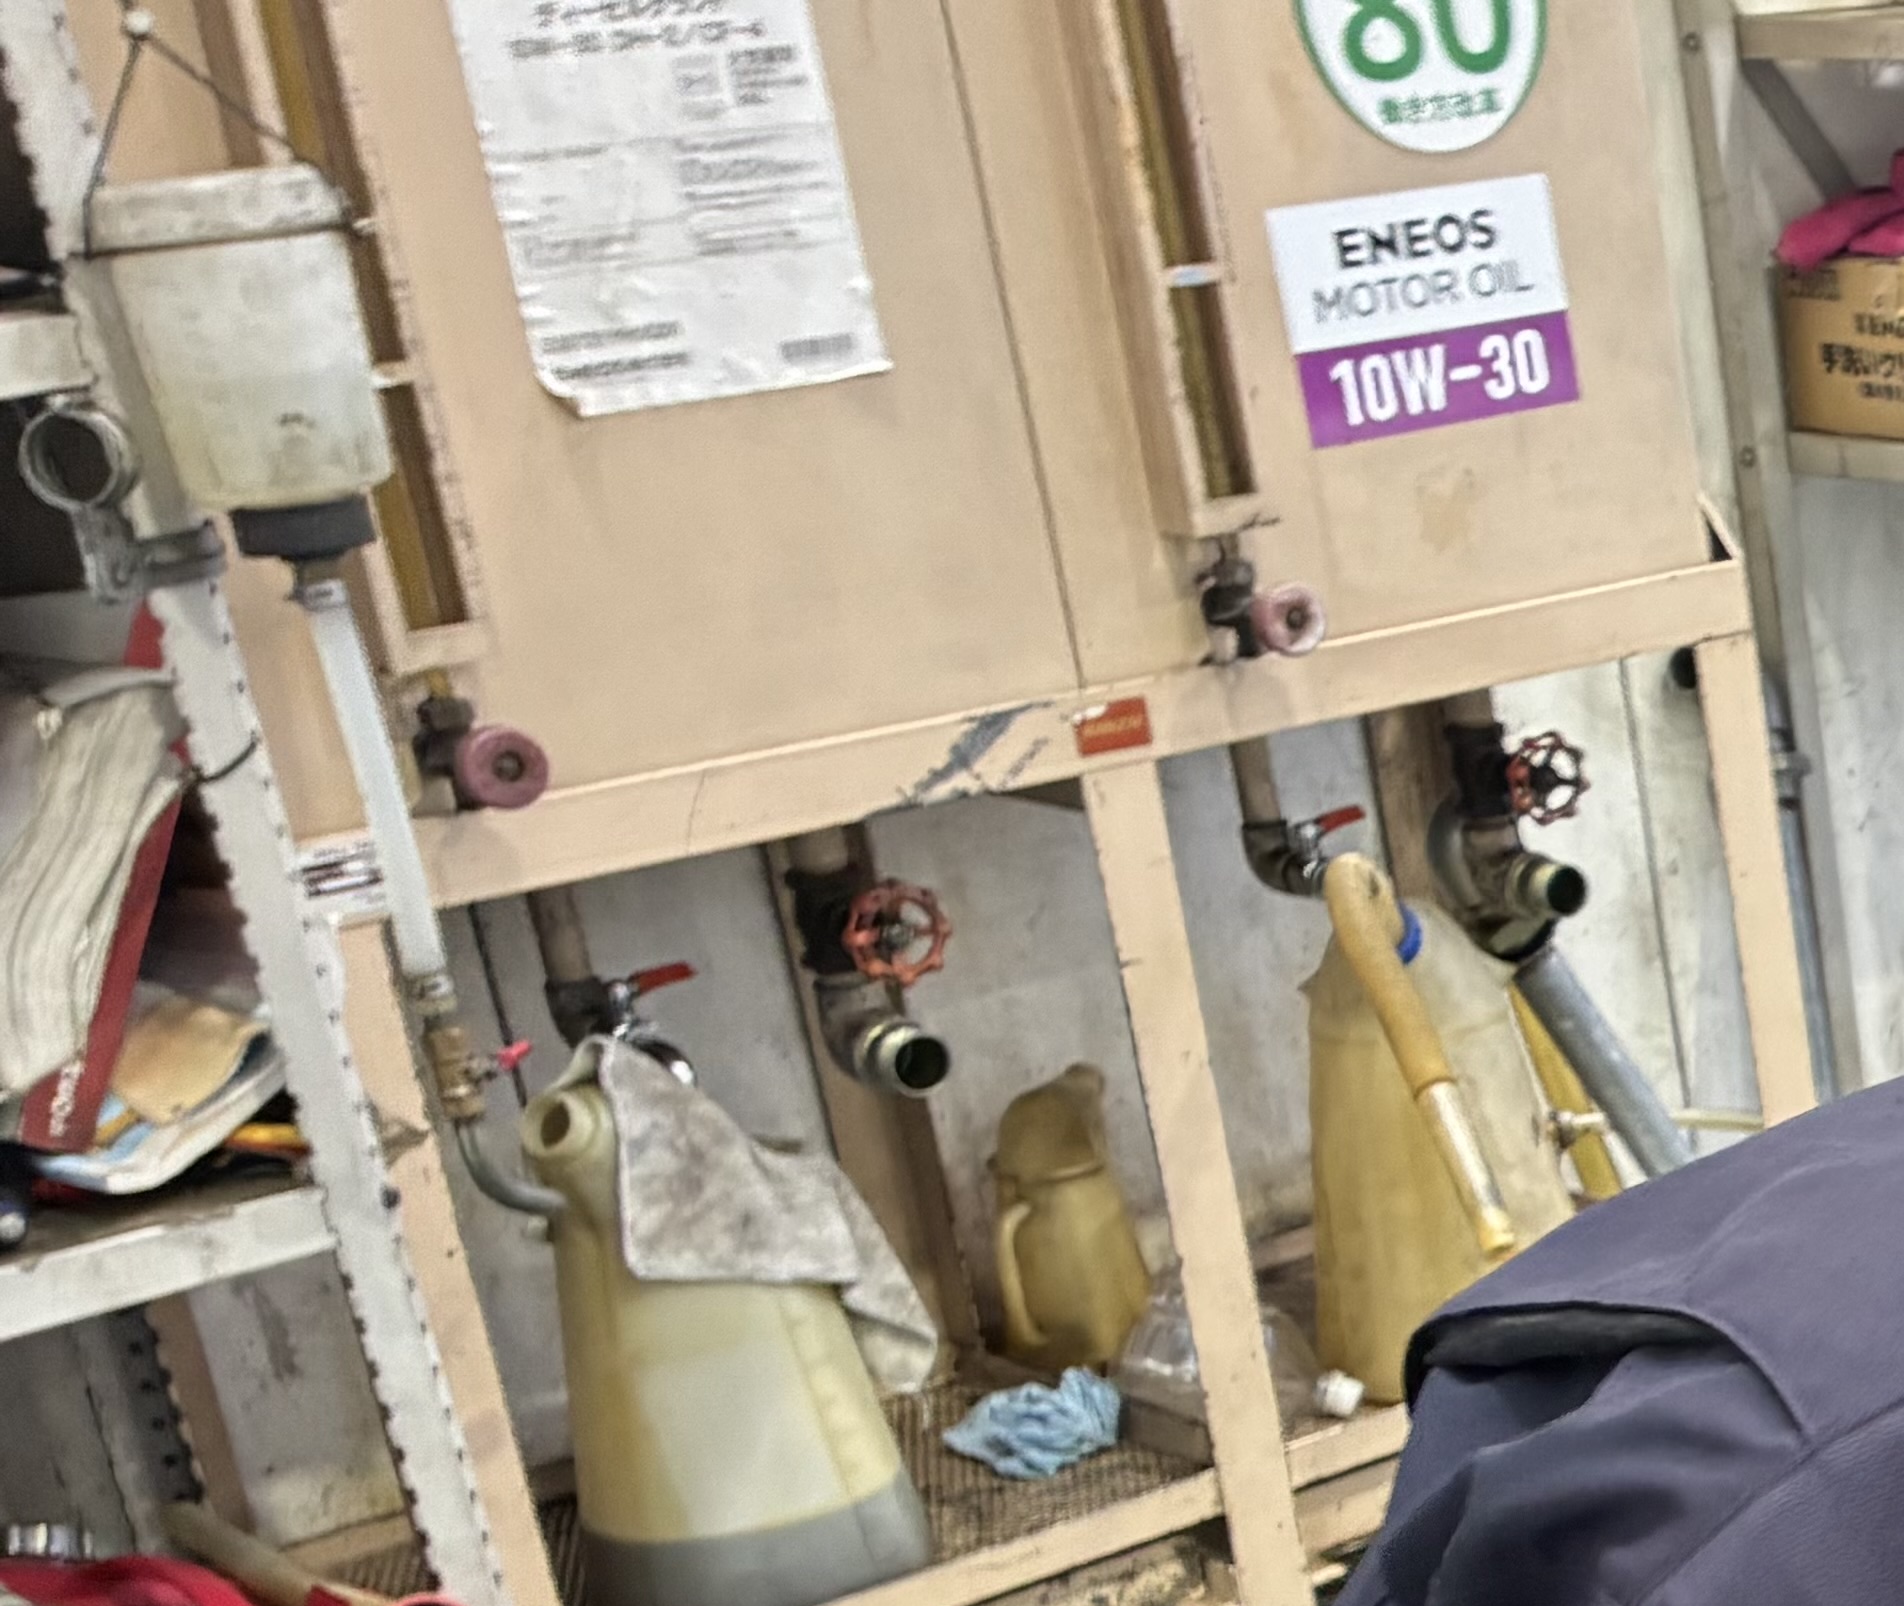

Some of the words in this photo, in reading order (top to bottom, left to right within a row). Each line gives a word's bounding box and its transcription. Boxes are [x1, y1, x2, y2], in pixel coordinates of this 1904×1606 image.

[1333, 209, 1498, 268] ENEOS
[1313, 268, 1462, 323] MOTOR
[1468, 260, 1535, 297] OIL
[1329, 328, 1551, 427] 10W-30
